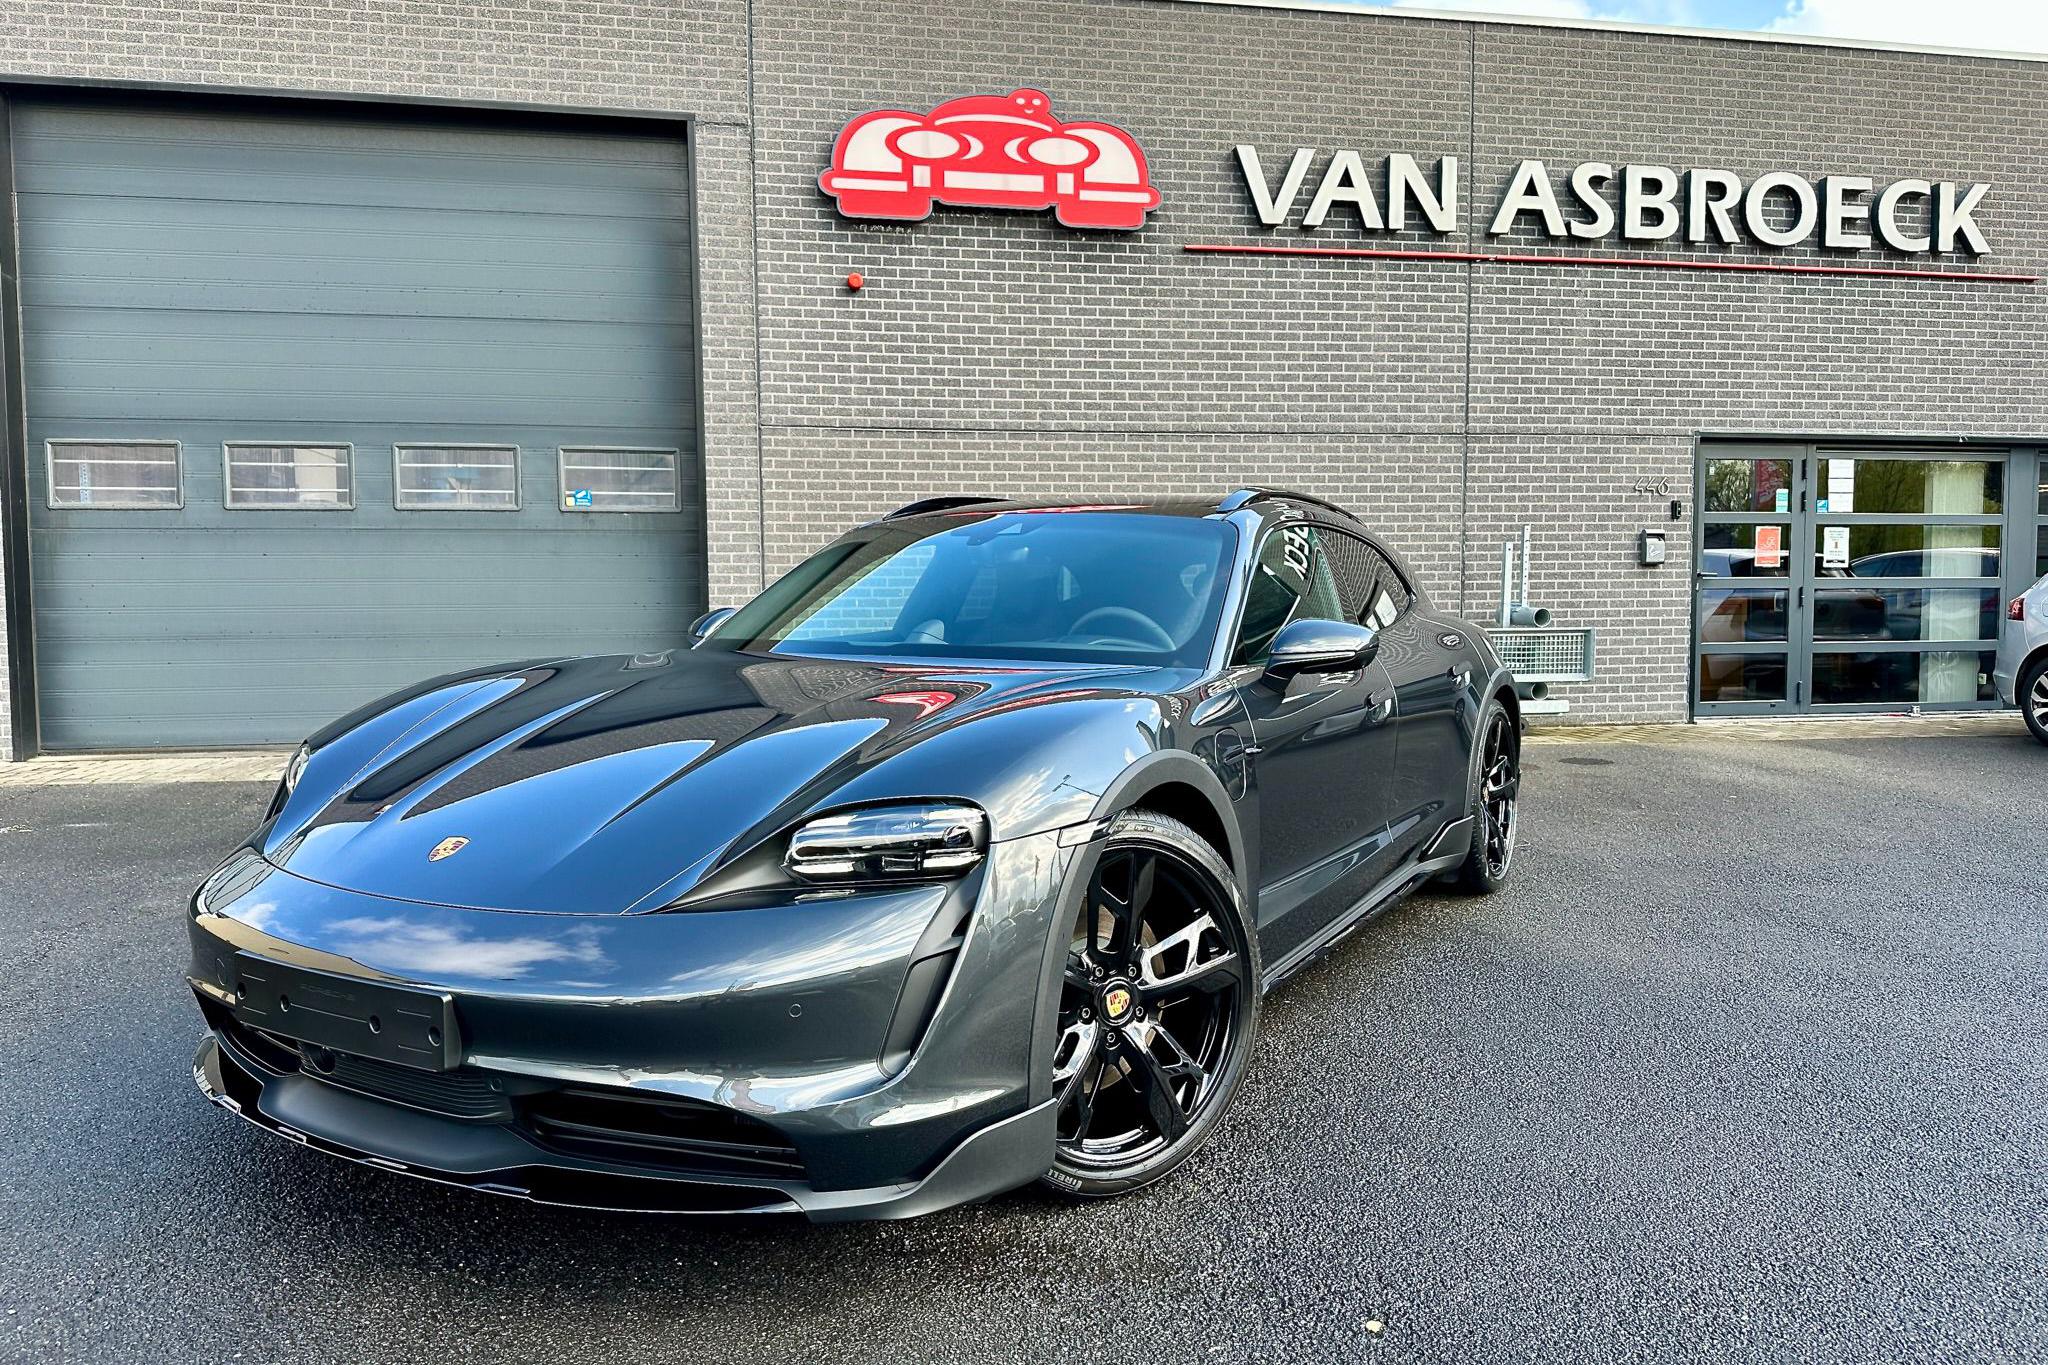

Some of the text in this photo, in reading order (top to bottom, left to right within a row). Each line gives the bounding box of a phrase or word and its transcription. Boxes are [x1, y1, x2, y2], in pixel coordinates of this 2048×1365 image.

[1234, 145, 1992, 255] VAN ASBROECK
[1635, 476, 1669, 496] 446
